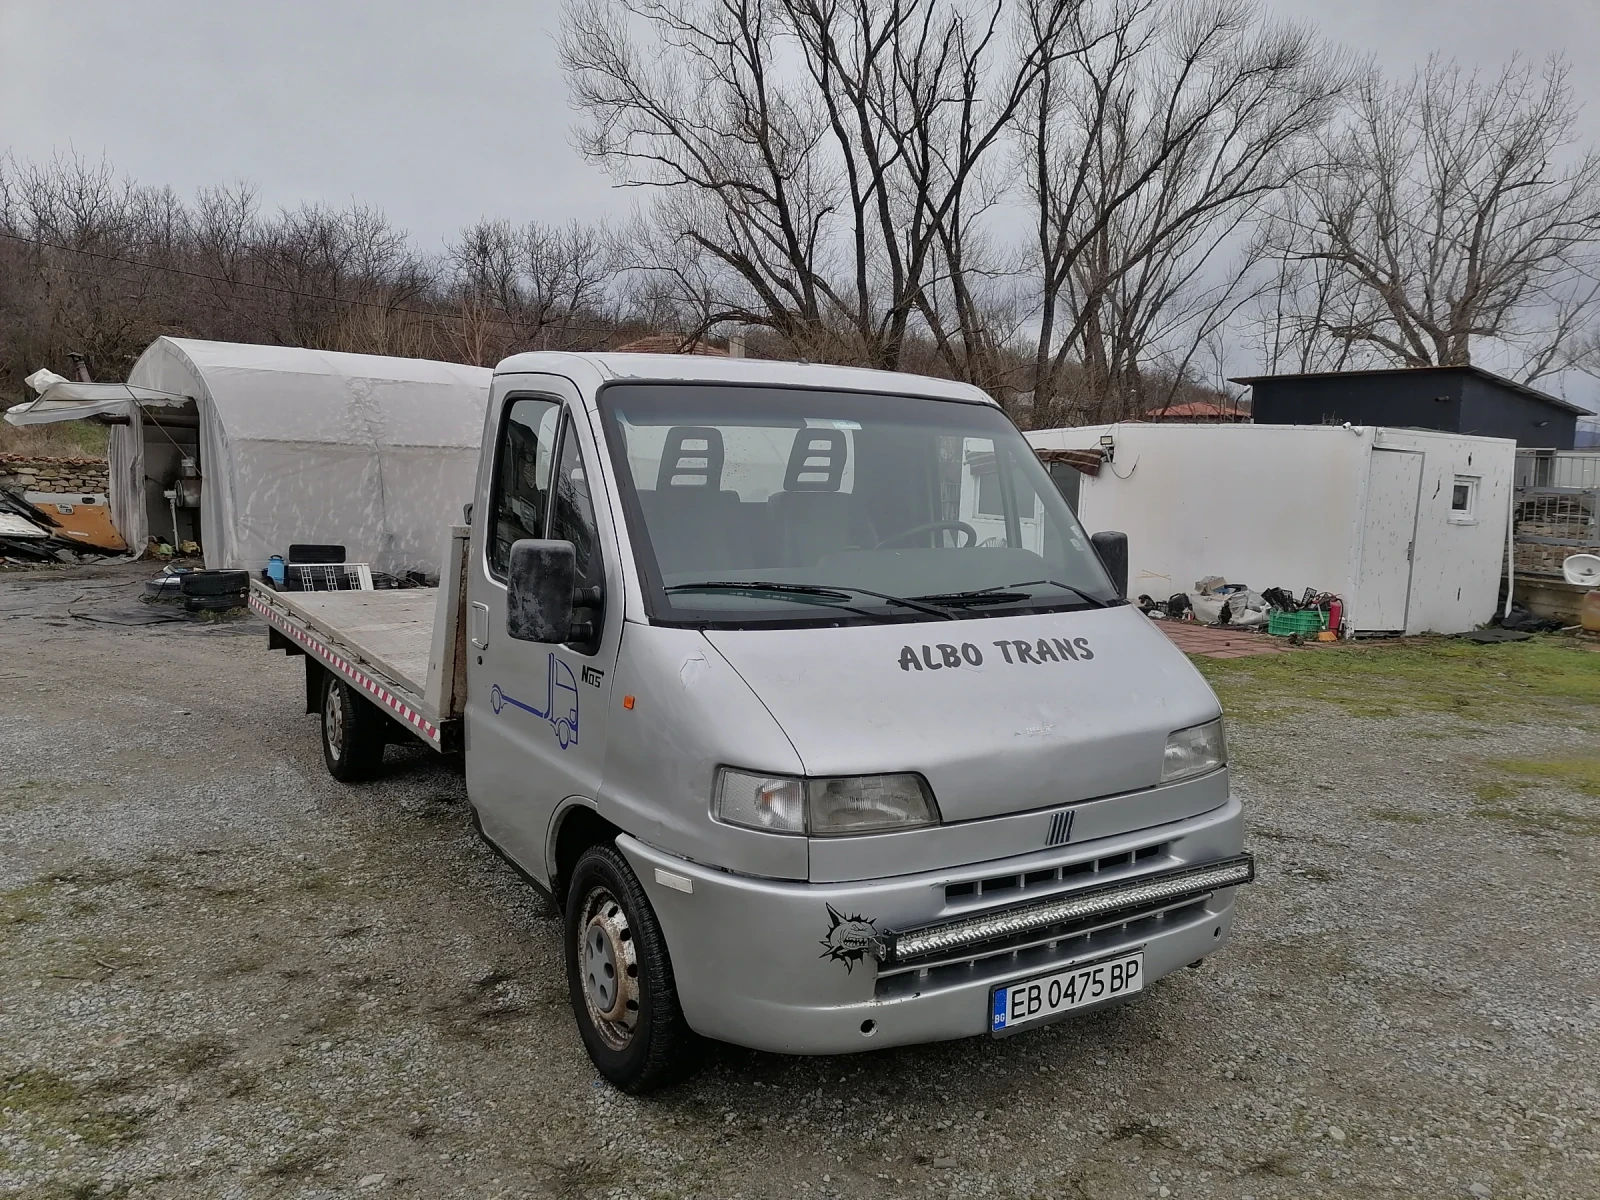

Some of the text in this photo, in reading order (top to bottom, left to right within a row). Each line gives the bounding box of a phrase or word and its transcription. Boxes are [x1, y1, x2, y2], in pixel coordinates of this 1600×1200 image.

[898, 637, 1094, 671] ALBO TRANS
[1011, 959, 1139, 1019] EB 0475 BP
[994, 1013, 1005, 1023] BG
